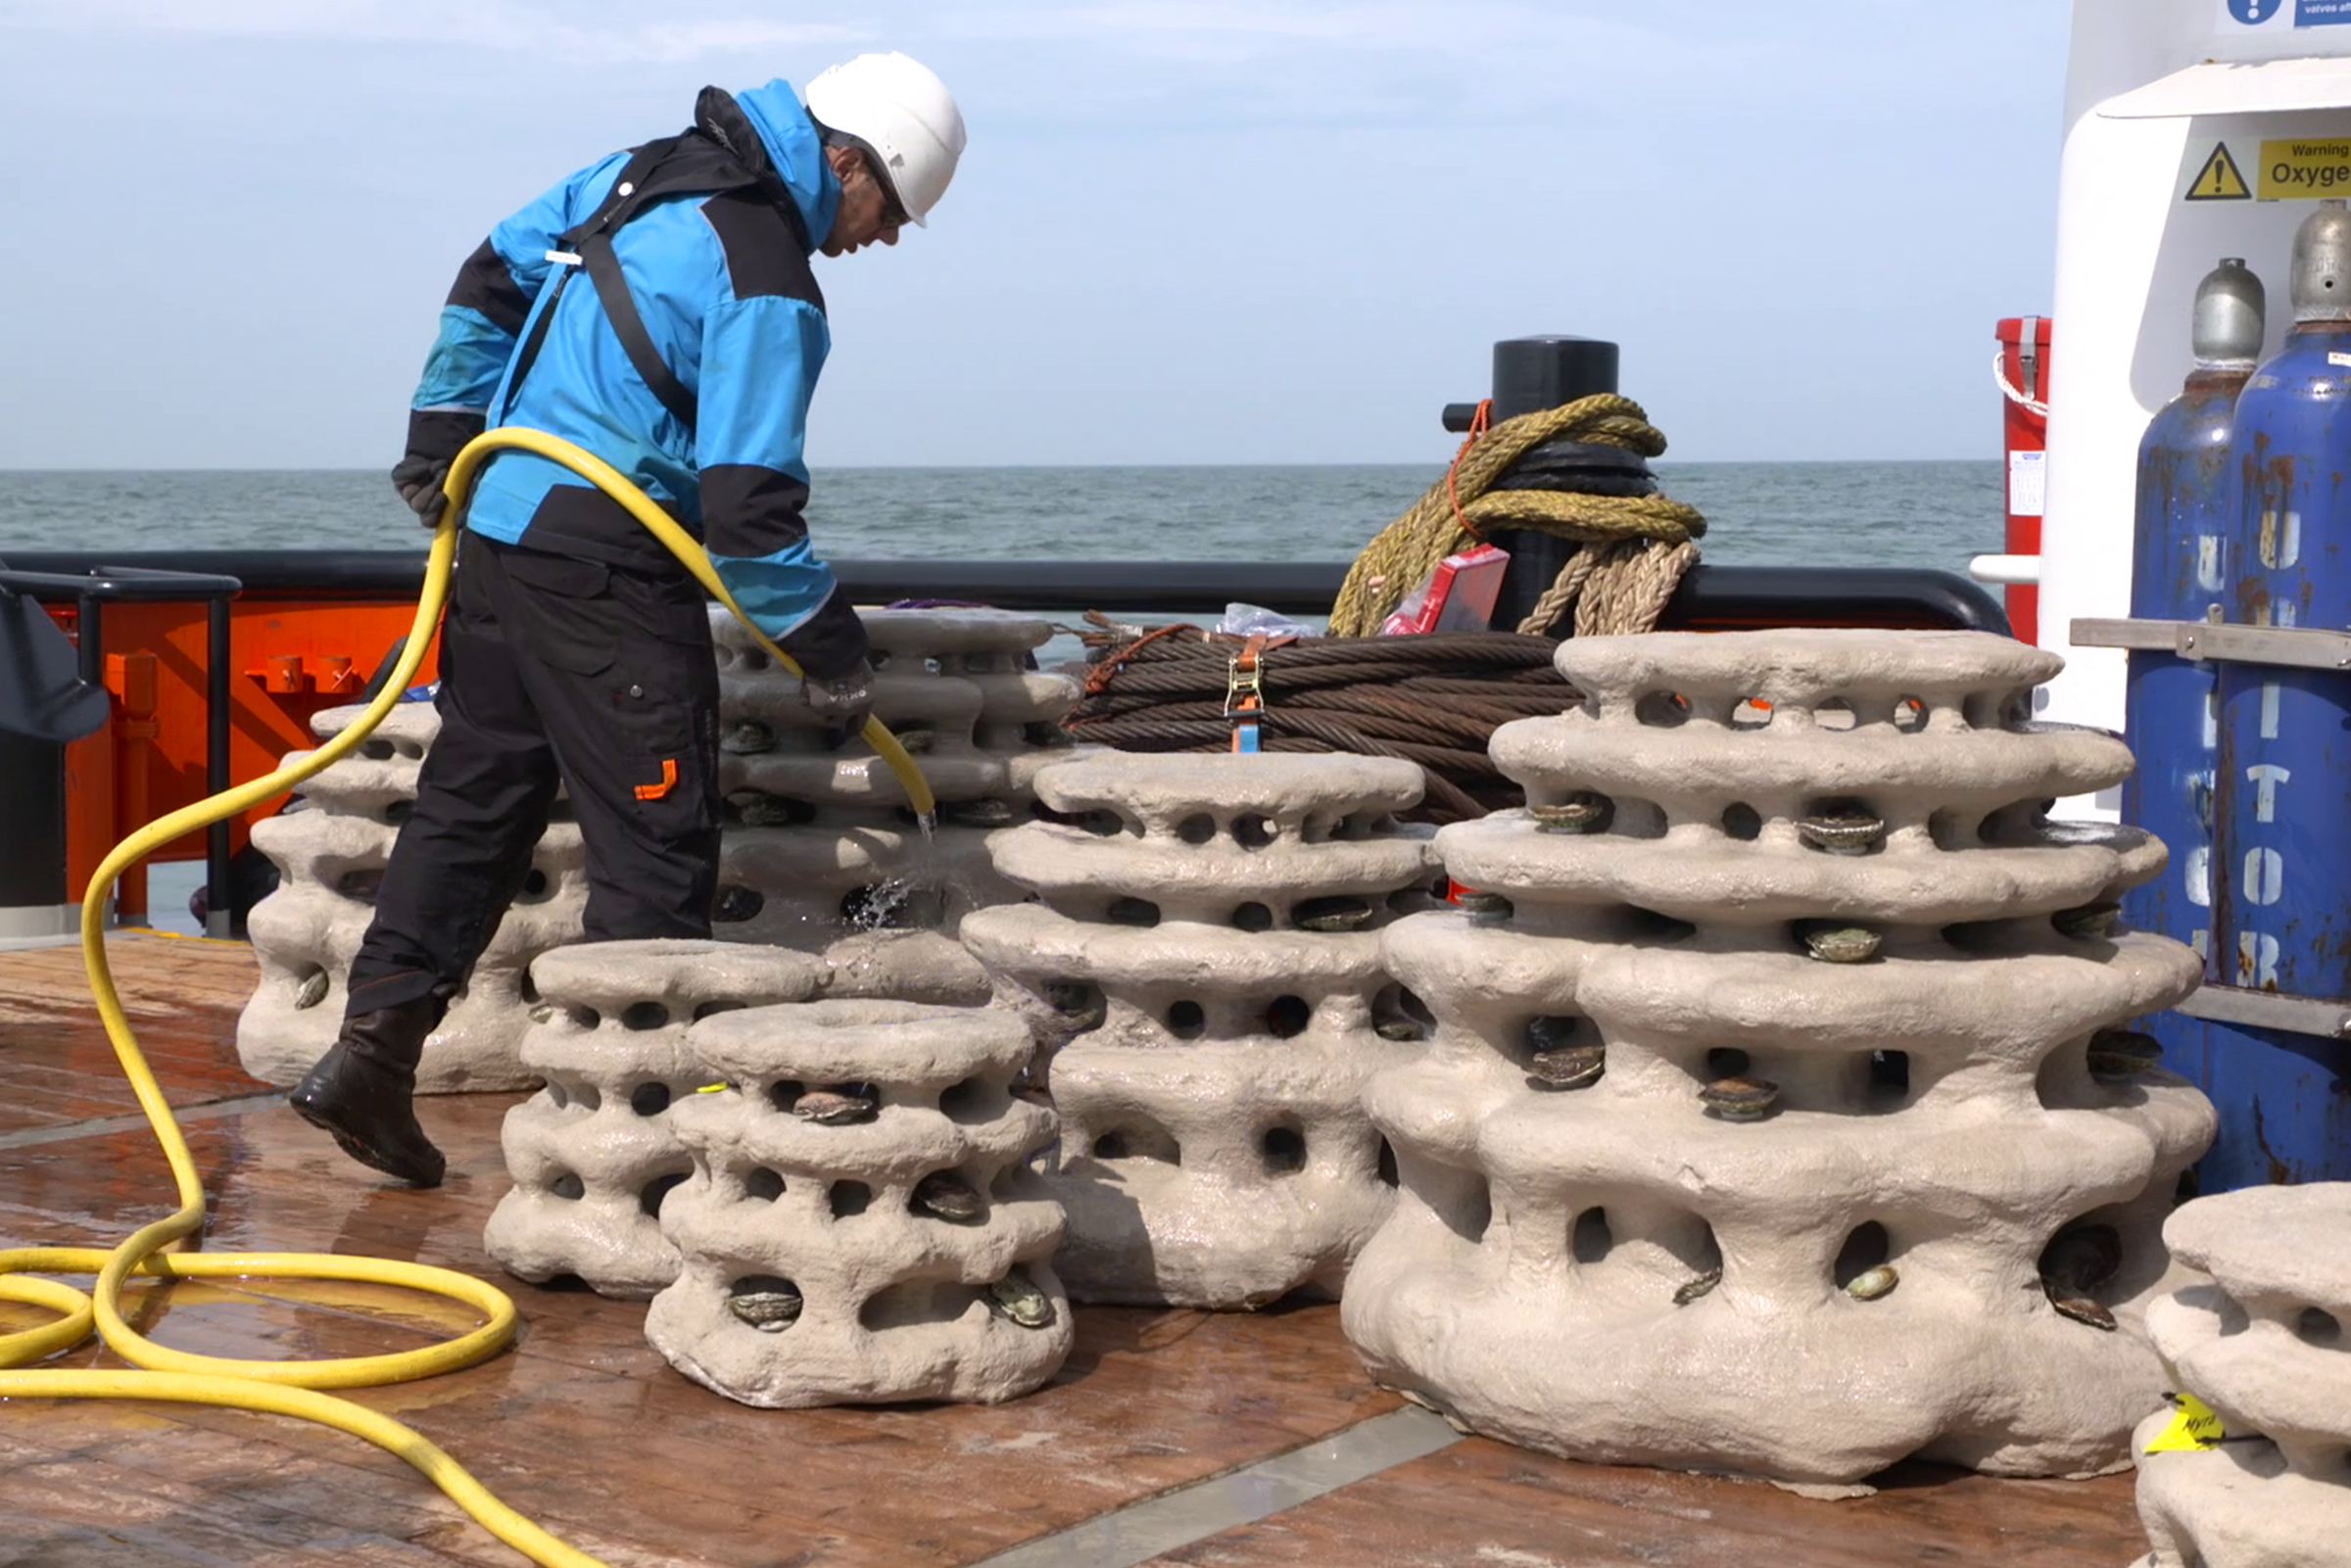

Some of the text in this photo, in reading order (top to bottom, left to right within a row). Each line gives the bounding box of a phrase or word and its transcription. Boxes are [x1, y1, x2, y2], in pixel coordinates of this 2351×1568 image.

[2304, 5, 2337, 15] valves
[2291, 143, 2349, 158] Warning
[2272, 163, 2351, 188] Oxyge
